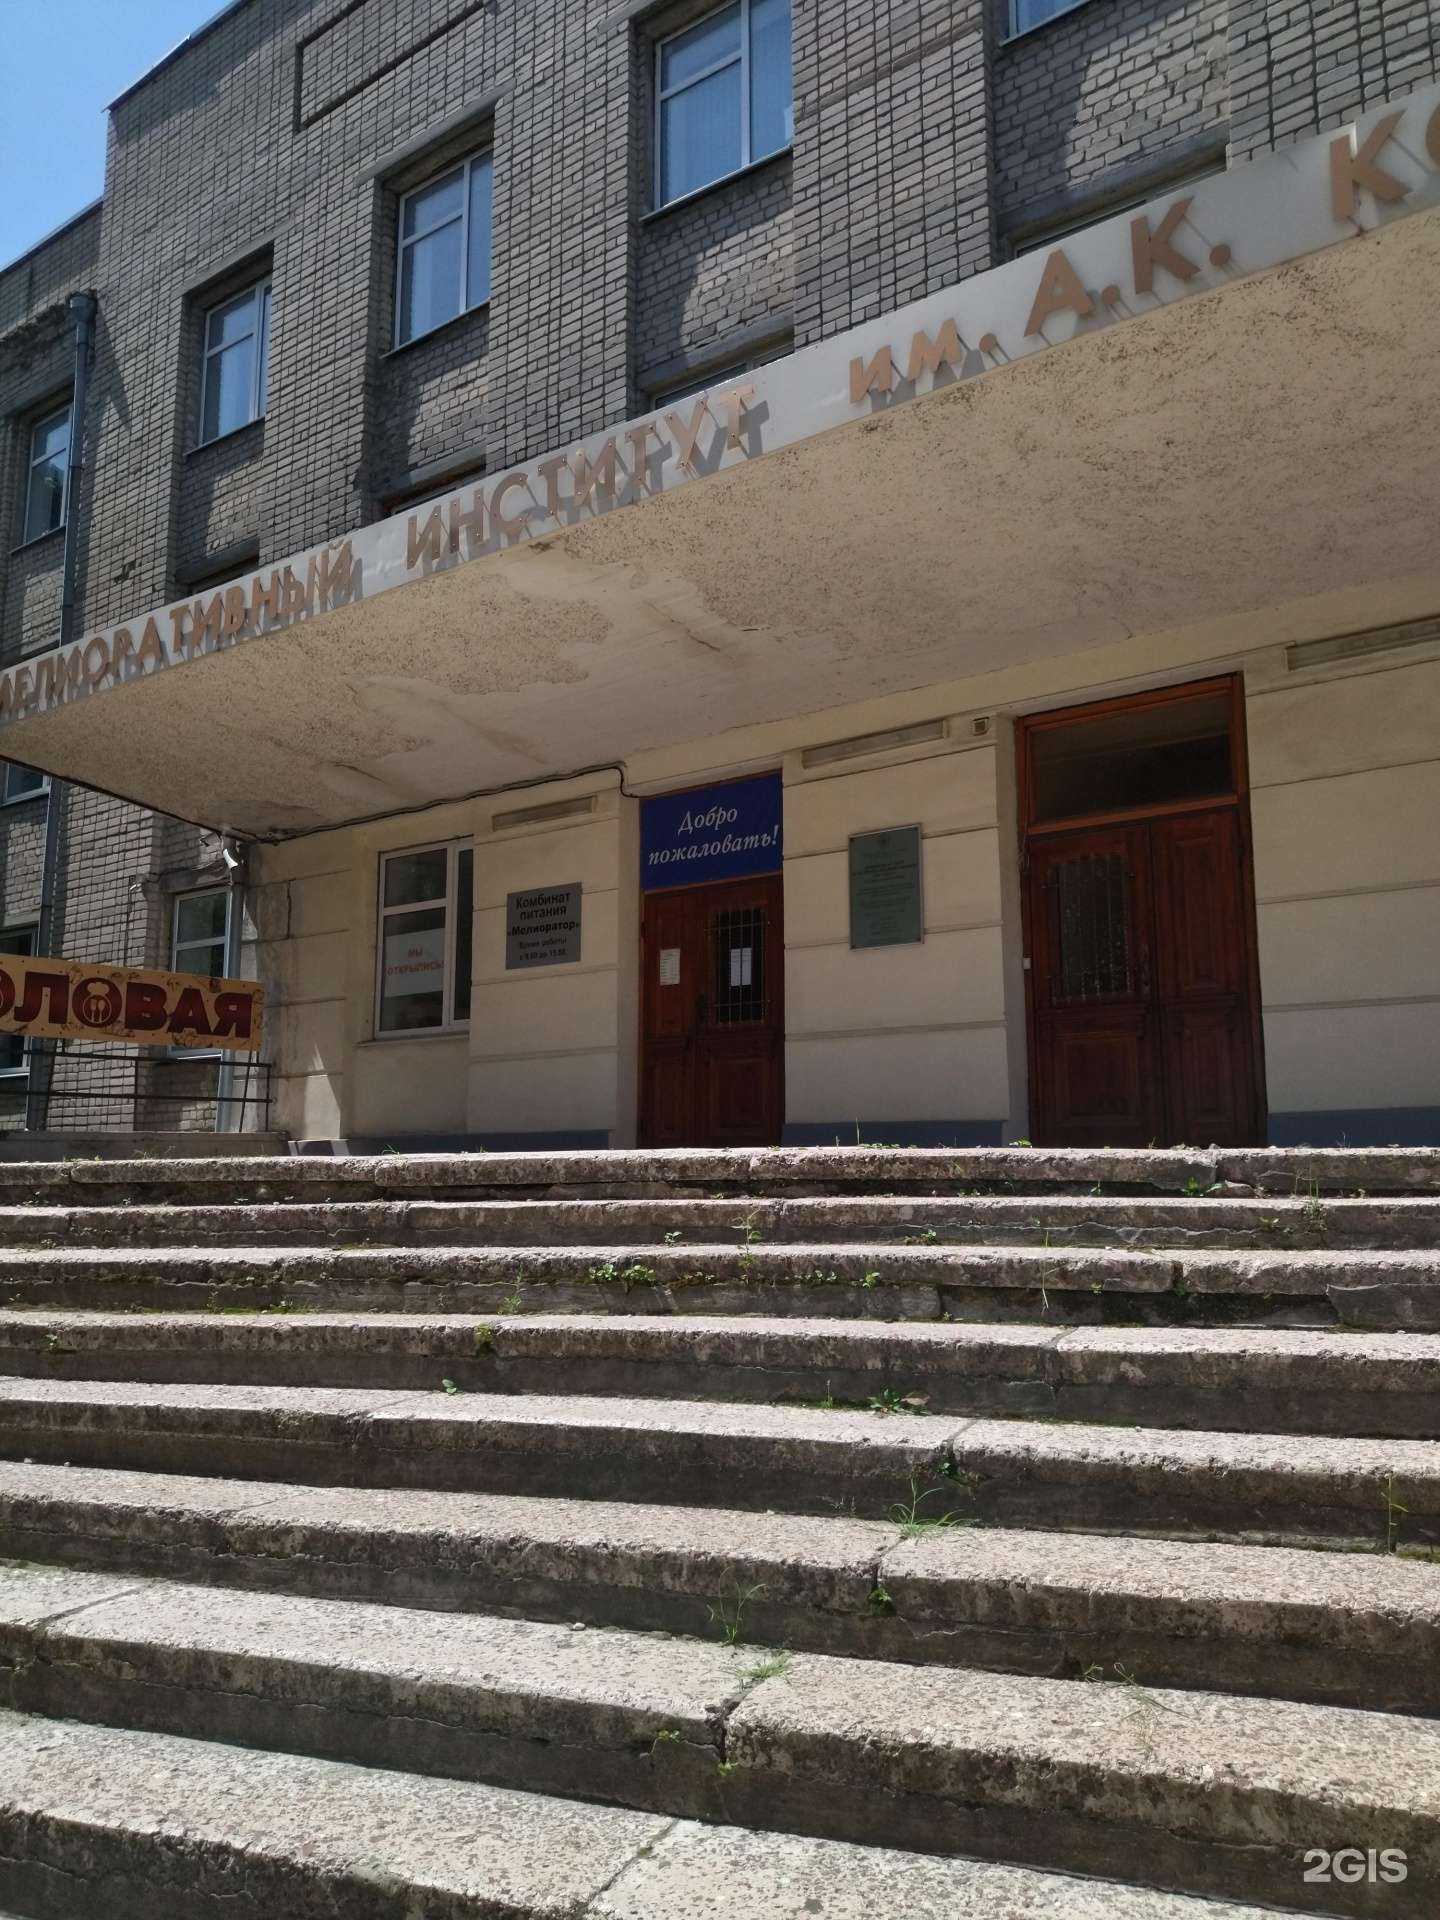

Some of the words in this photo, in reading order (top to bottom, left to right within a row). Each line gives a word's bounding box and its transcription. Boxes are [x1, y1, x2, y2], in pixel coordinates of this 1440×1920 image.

[406, 384, 755, 570] ИНСТИТУТ
[1023, 195, 1232, 338] А.К.
[1330, 101, 1440, 224] К
[677, 803, 738, 838] Добро
[648, 824, 780, 866] пожаловать!
[516, 892, 571, 910] Комбинат
[520, 905, 567, 921] питания
